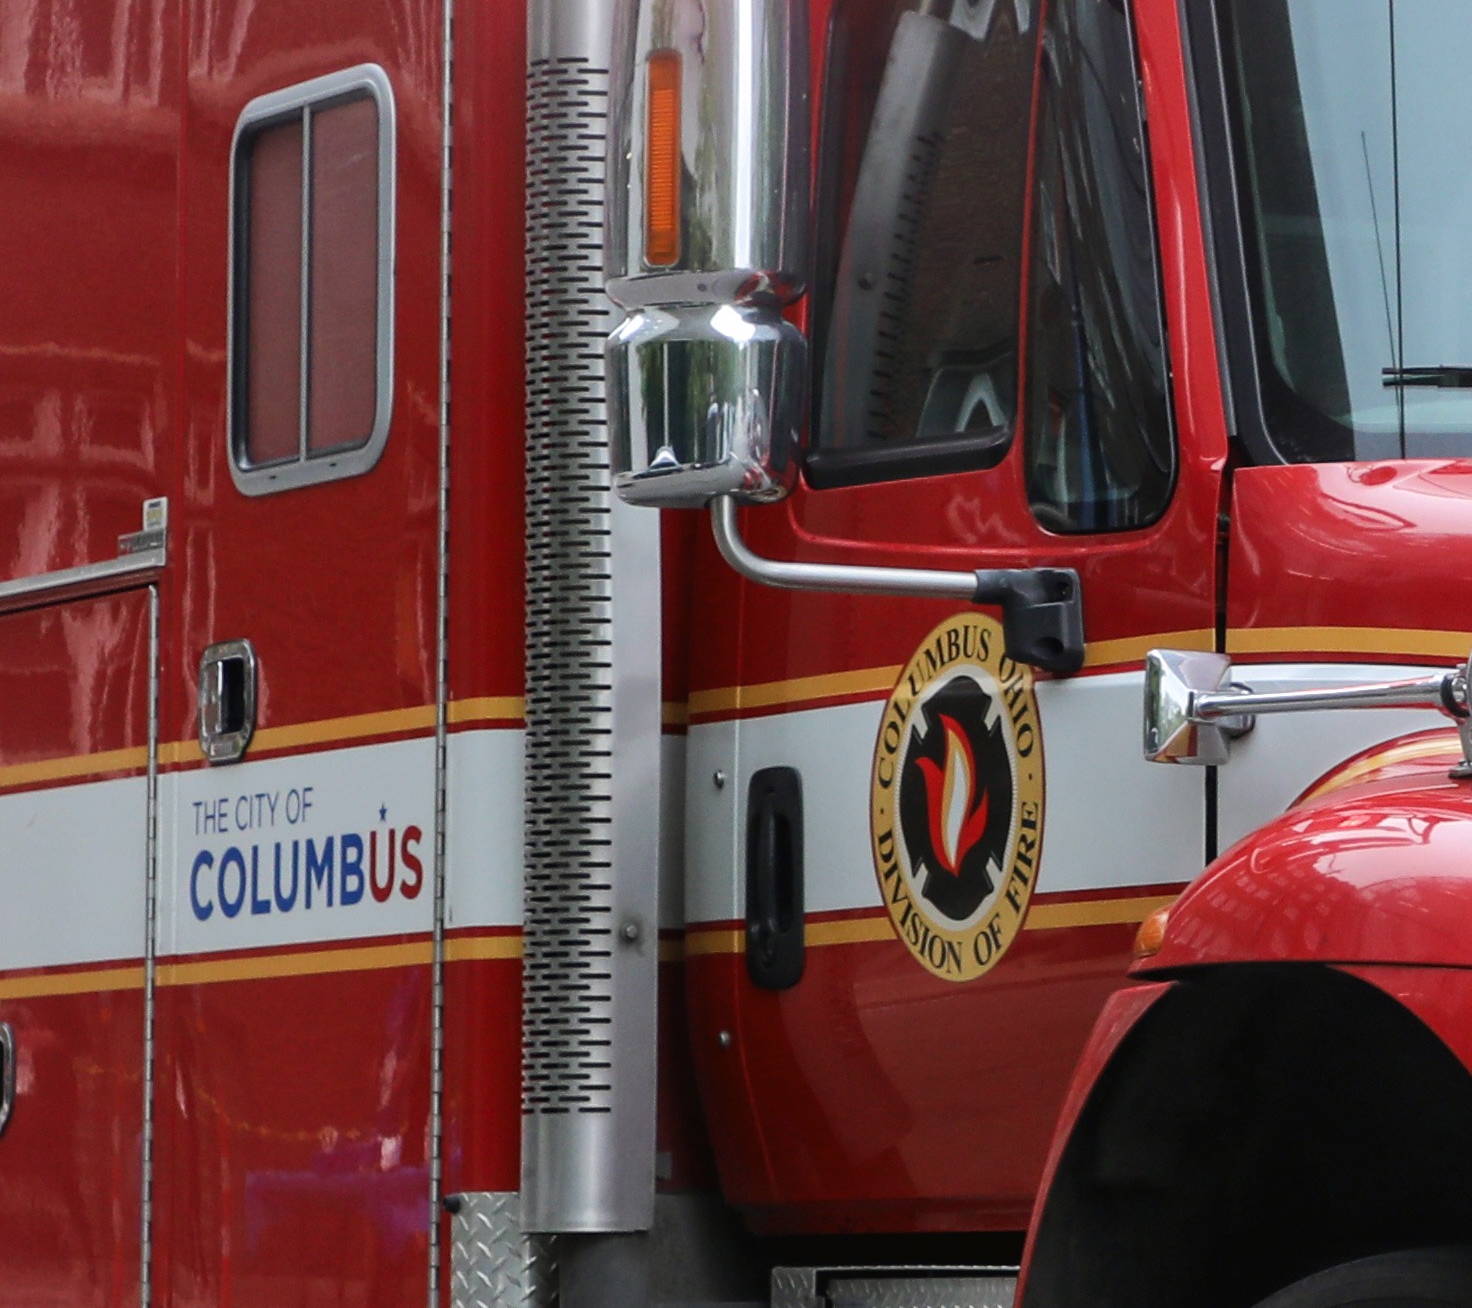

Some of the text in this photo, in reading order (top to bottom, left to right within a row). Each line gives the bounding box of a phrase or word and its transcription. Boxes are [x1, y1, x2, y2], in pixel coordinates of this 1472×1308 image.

[878, 625, 1035, 789] COLUMBUS OHIO
[190, 824, 423, 921] COLUMBUS
[192, 787, 314, 834] THE CITY OF
[878, 801, 1040, 975] DIVISION OF FIRE
